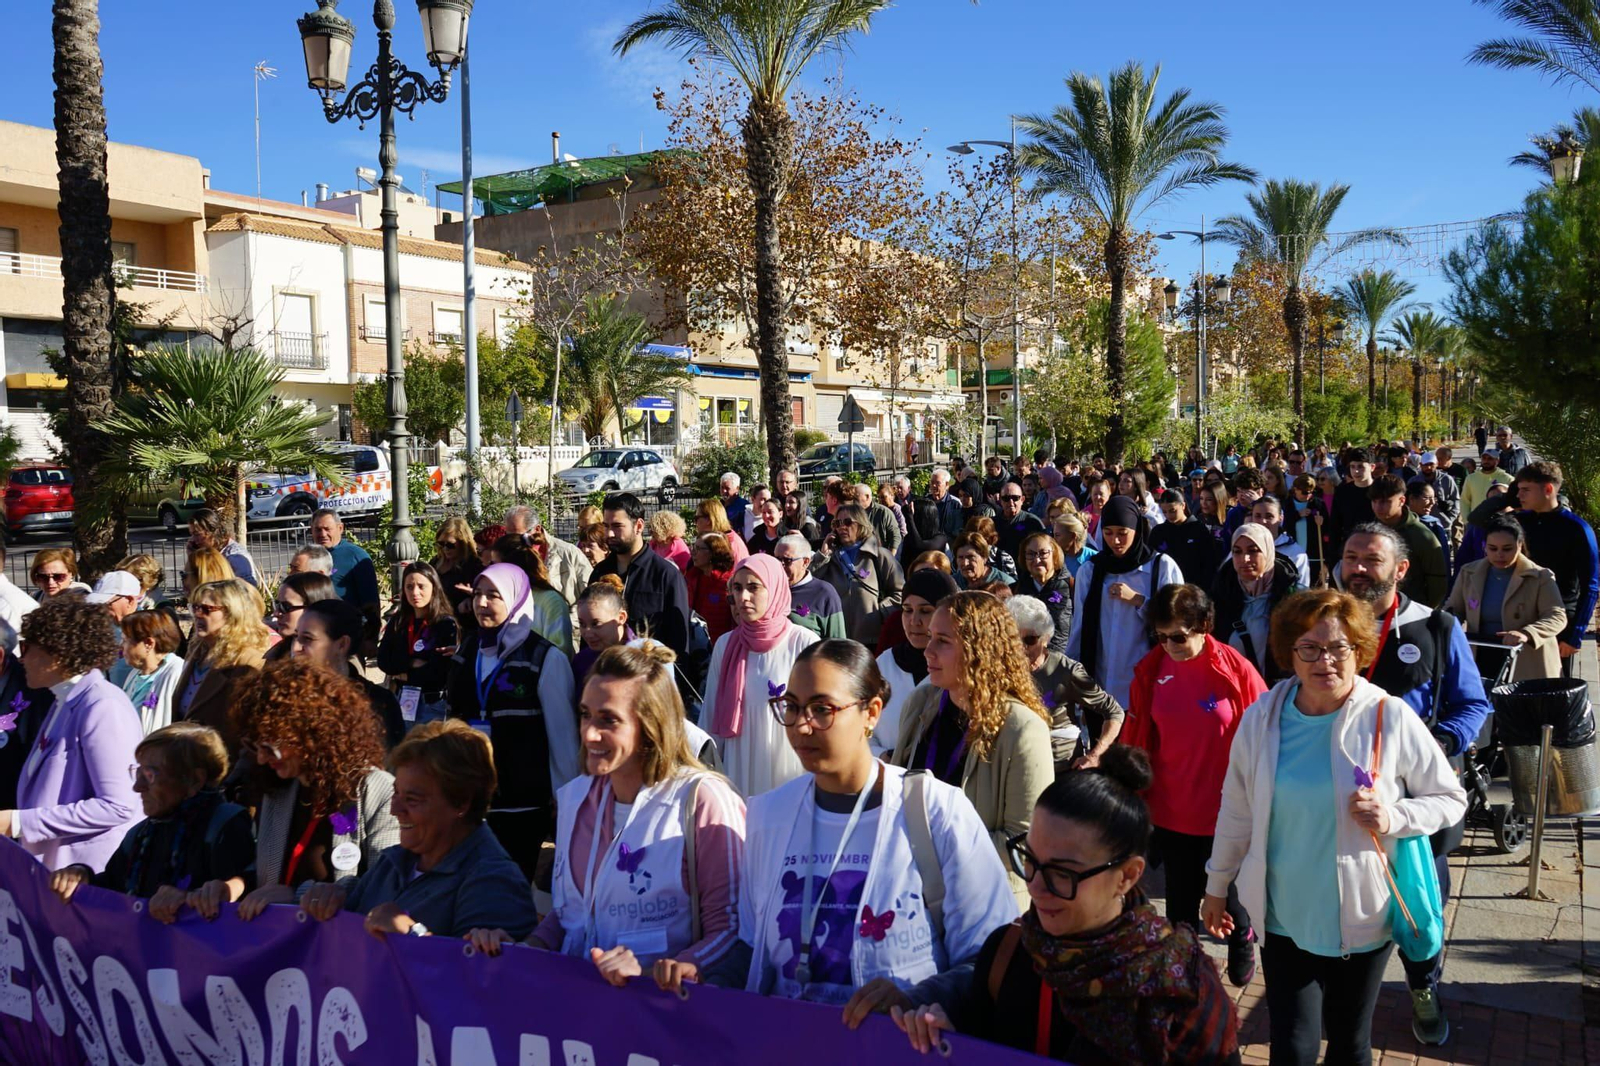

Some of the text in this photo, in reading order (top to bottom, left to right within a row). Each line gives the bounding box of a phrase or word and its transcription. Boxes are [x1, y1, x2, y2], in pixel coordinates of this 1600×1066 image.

[367, 494, 386, 503] CIVIL
[785, 855, 797, 867] 25
[608, 896, 677, 919] engloba
